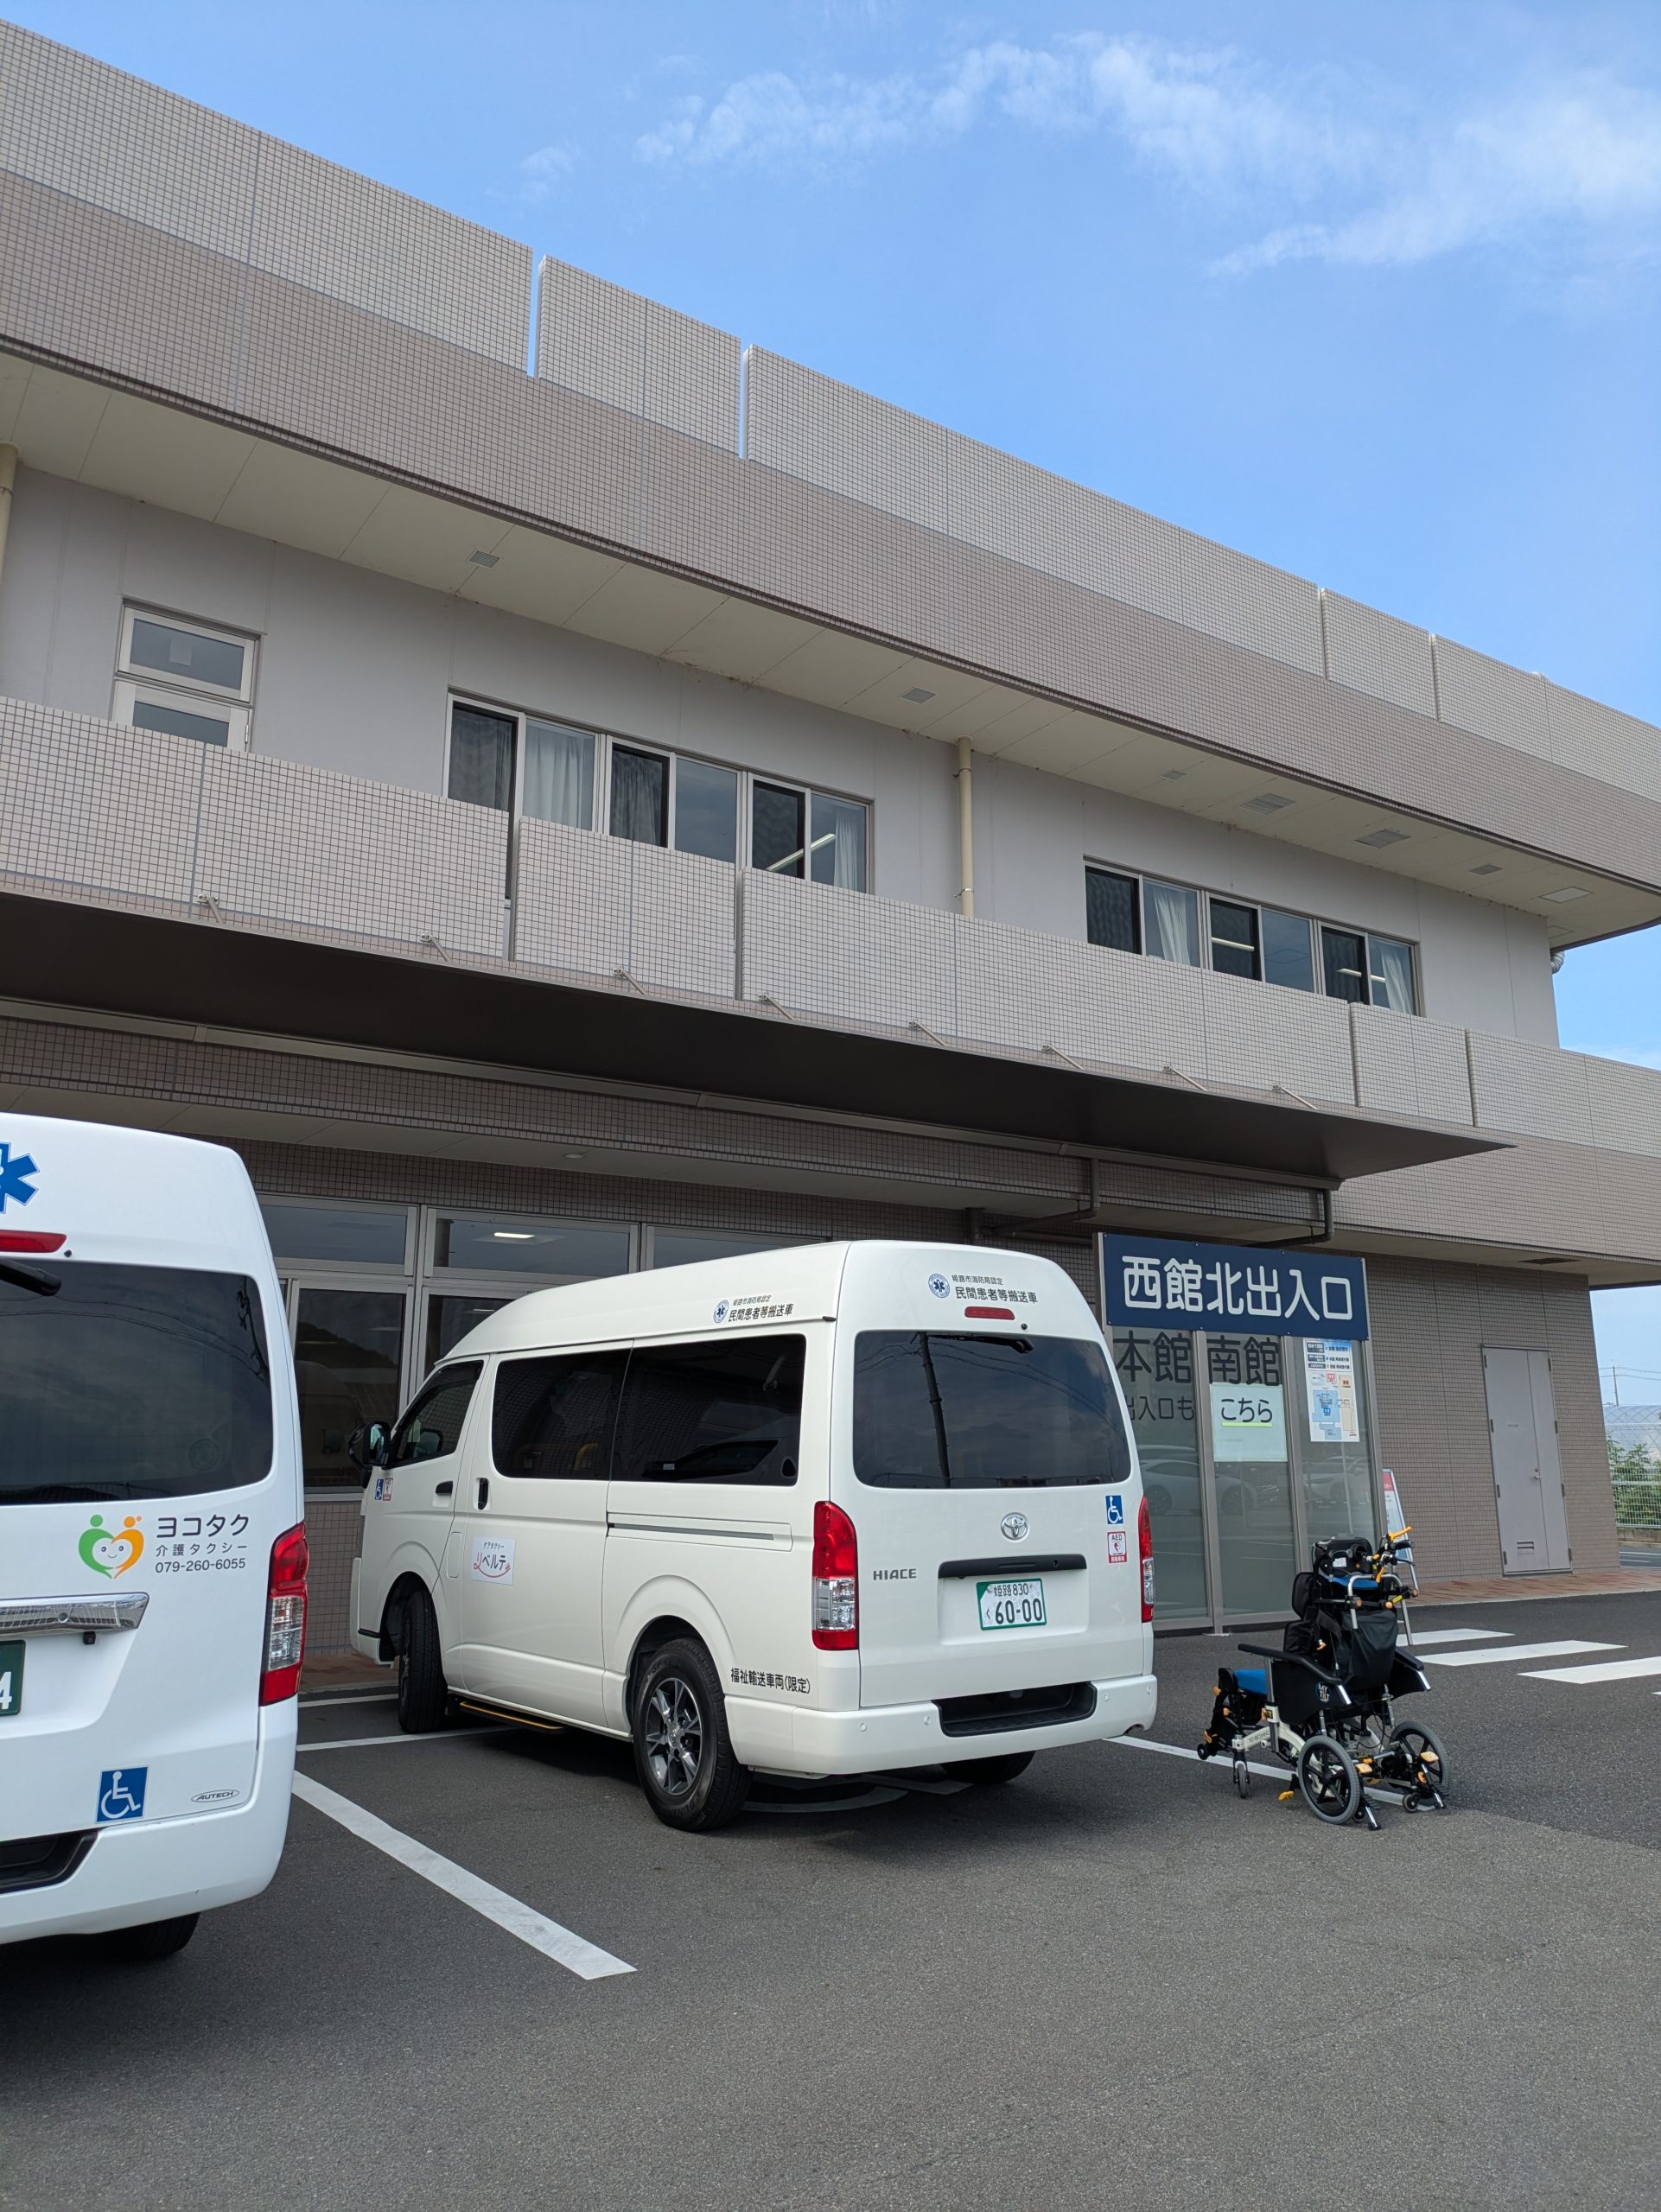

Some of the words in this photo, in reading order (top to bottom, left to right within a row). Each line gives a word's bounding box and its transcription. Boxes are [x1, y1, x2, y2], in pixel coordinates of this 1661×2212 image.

[955, 1287, 1038, 1304] 民間患者等搬送車
[1122, 1255, 1353, 1320] 西館北出入口
[729, 1303, 793, 1322] 民間患者等搬送車
[1113, 1330, 1192, 1383] 本館
[1207, 1335, 1280, 1386] 南館
[1221, 1397, 1273, 1423] こちら
[156, 1514, 249, 1538] ヨコタク
[156, 1541, 247, 1557] 介護タクシー
[156, 1558, 245, 1573] 079-260-6055
[873, 1568, 917, 1580] HIACE
[996, 1598, 1042, 1624] 60-00
[730, 1667, 811, 1694] 福祉輸送車両(限定)
[196, 1791, 234, 1802] AUTECH
